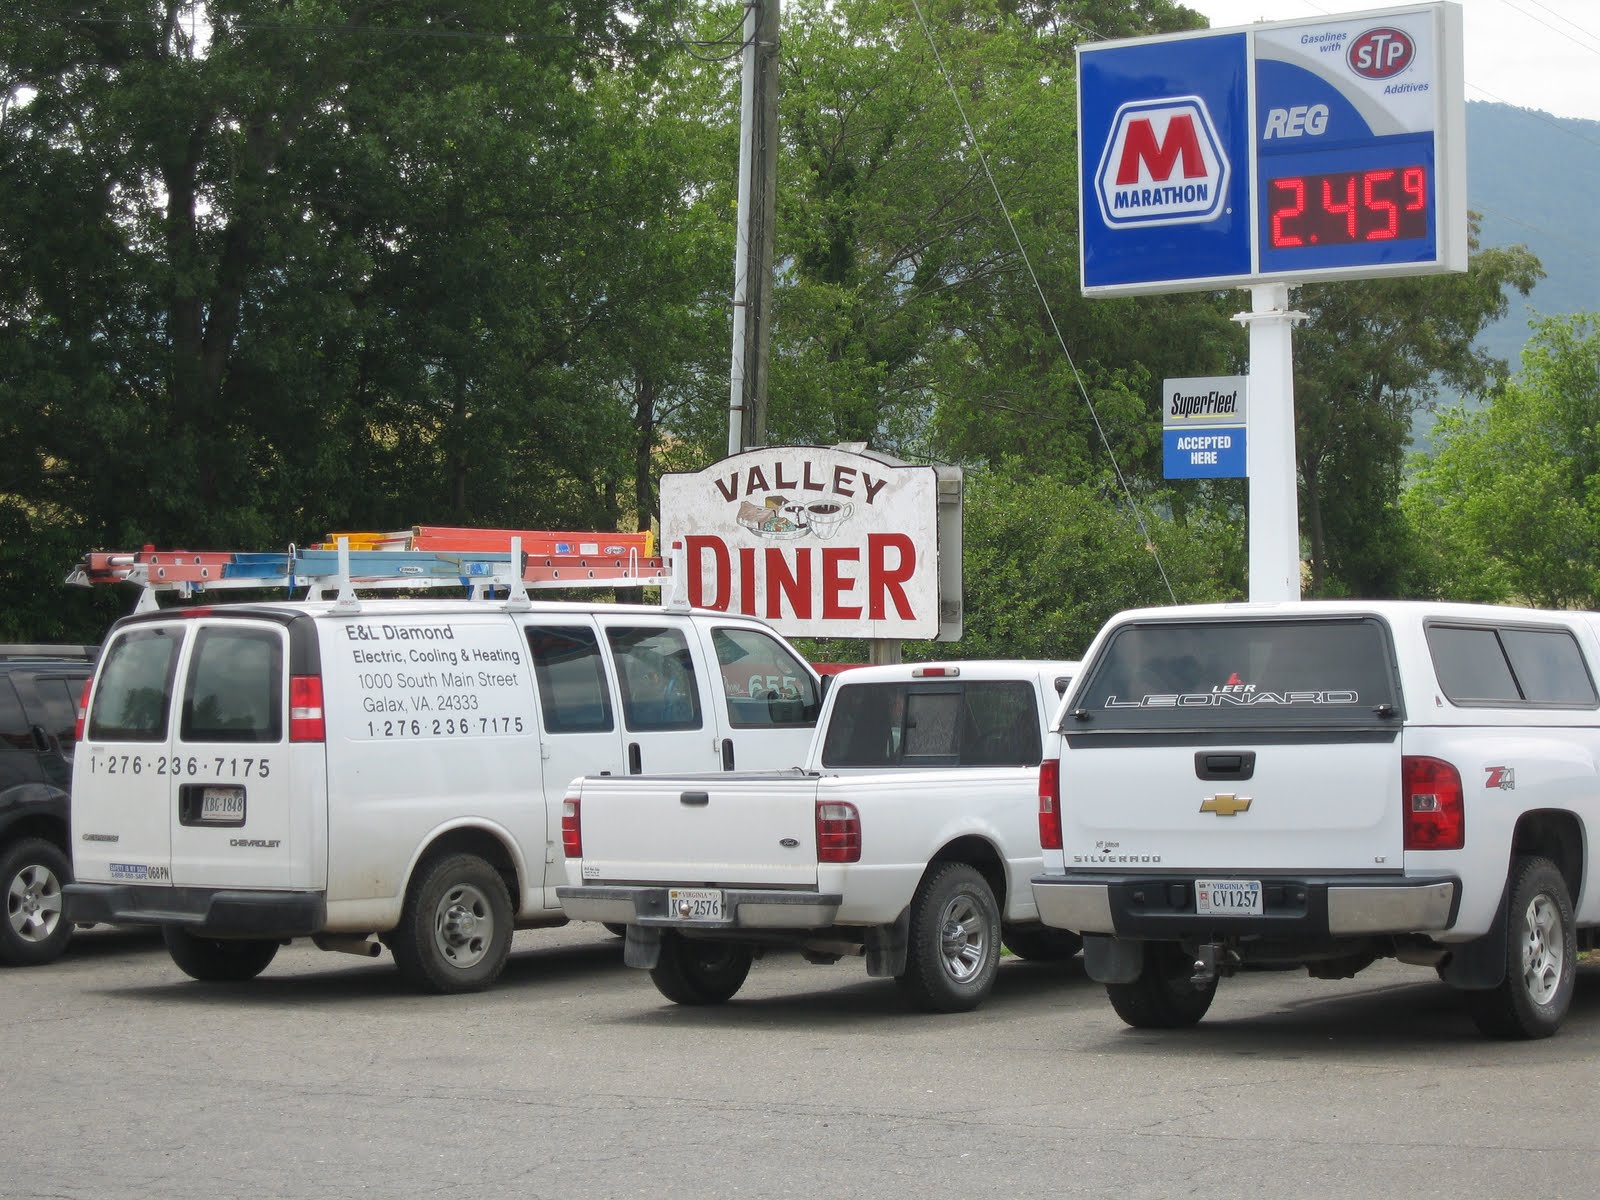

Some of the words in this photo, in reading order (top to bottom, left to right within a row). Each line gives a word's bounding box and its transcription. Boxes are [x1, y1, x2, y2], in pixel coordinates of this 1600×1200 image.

[1301, 32, 1347, 44] Gasolines
[1320, 43, 1341, 53] with
[1357, 34, 1404, 69] STP
[1384, 83, 1429, 94] Additives
[1264, 104, 1329, 139] REG
[1114, 184, 1208, 209] MARATHON
[1171, 391, 1237, 418] SuperFleet
[1177, 436, 1231, 450] ACCEPTED
[1191, 452, 1217, 464] HERE
[714, 461, 887, 504] VALLEY
[684, 533, 916, 620] DINER
[345, 625, 380, 641] E&L
[382, 624, 454, 640] Diamond
[353, 650, 407, 665] Electric,
[409, 649, 458, 666] Cooling
[461, 649, 470, 662] &
[473, 649, 521, 665] Heating
[358, 673, 393, 689] 1000
[397, 672, 438, 688] South
[441, 672, 475, 687] Main
[478, 671, 519, 687] Street
[1212, 684, 1256, 693] LEER
[363, 697, 408, 713] Galax,
[411, 696, 434, 711] VA.
[438, 695, 479, 711] 24333
[1104, 691, 1359, 708] LEONARD
[230, 839, 281, 848] CHEVROLET
[1073, 855, 1162, 863] SILVERADO
[1213, 890, 1258, 907] CV1257
